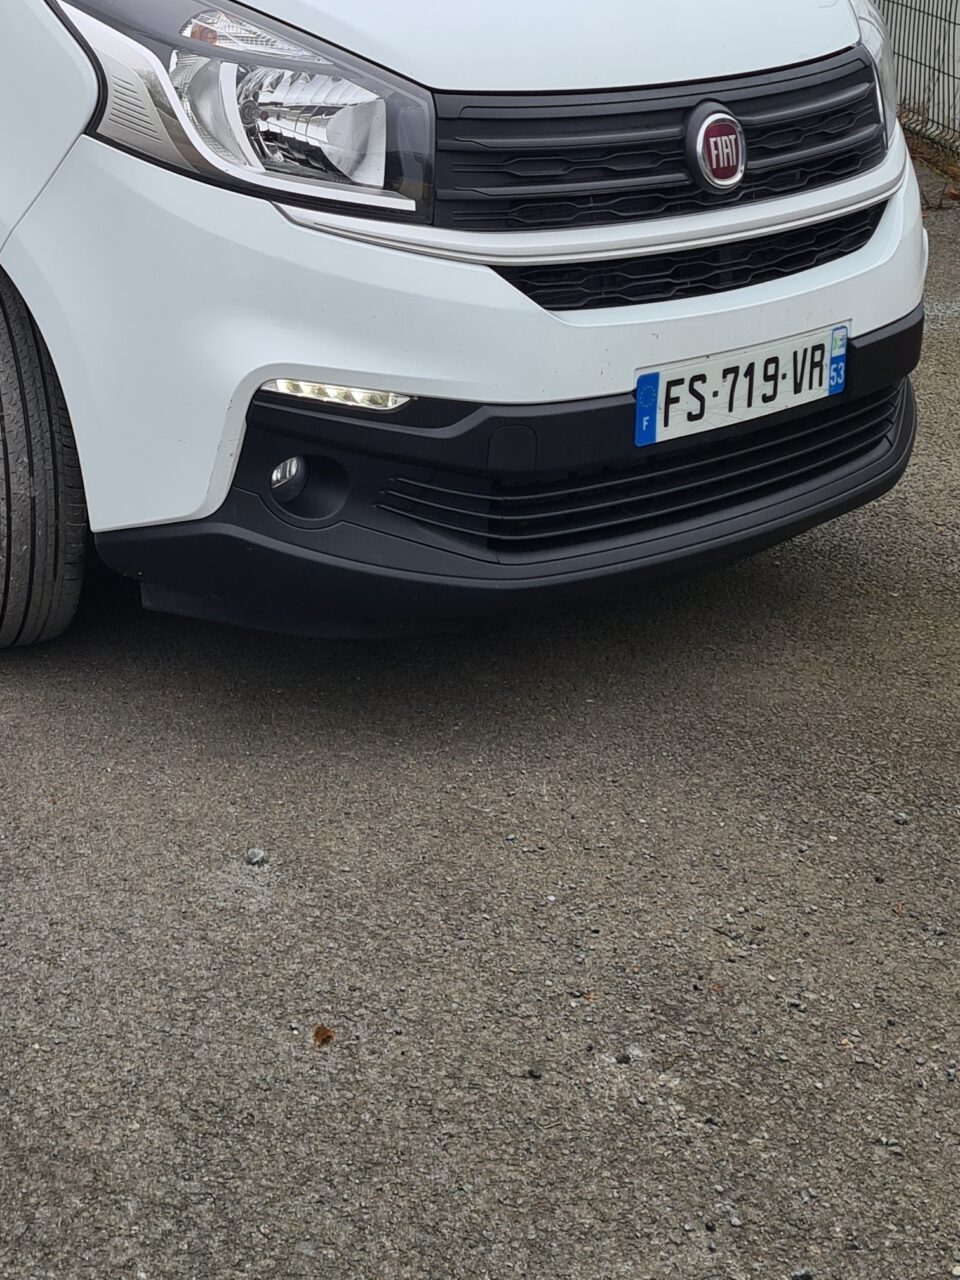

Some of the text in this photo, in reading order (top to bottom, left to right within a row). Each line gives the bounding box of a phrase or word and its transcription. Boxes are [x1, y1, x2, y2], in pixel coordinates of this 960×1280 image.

[709, 134, 737, 169] FIAT
[663, 342, 826, 428] FS-719-VR
[829, 361, 845, 386] 53
[642, 415, 650, 432] F
